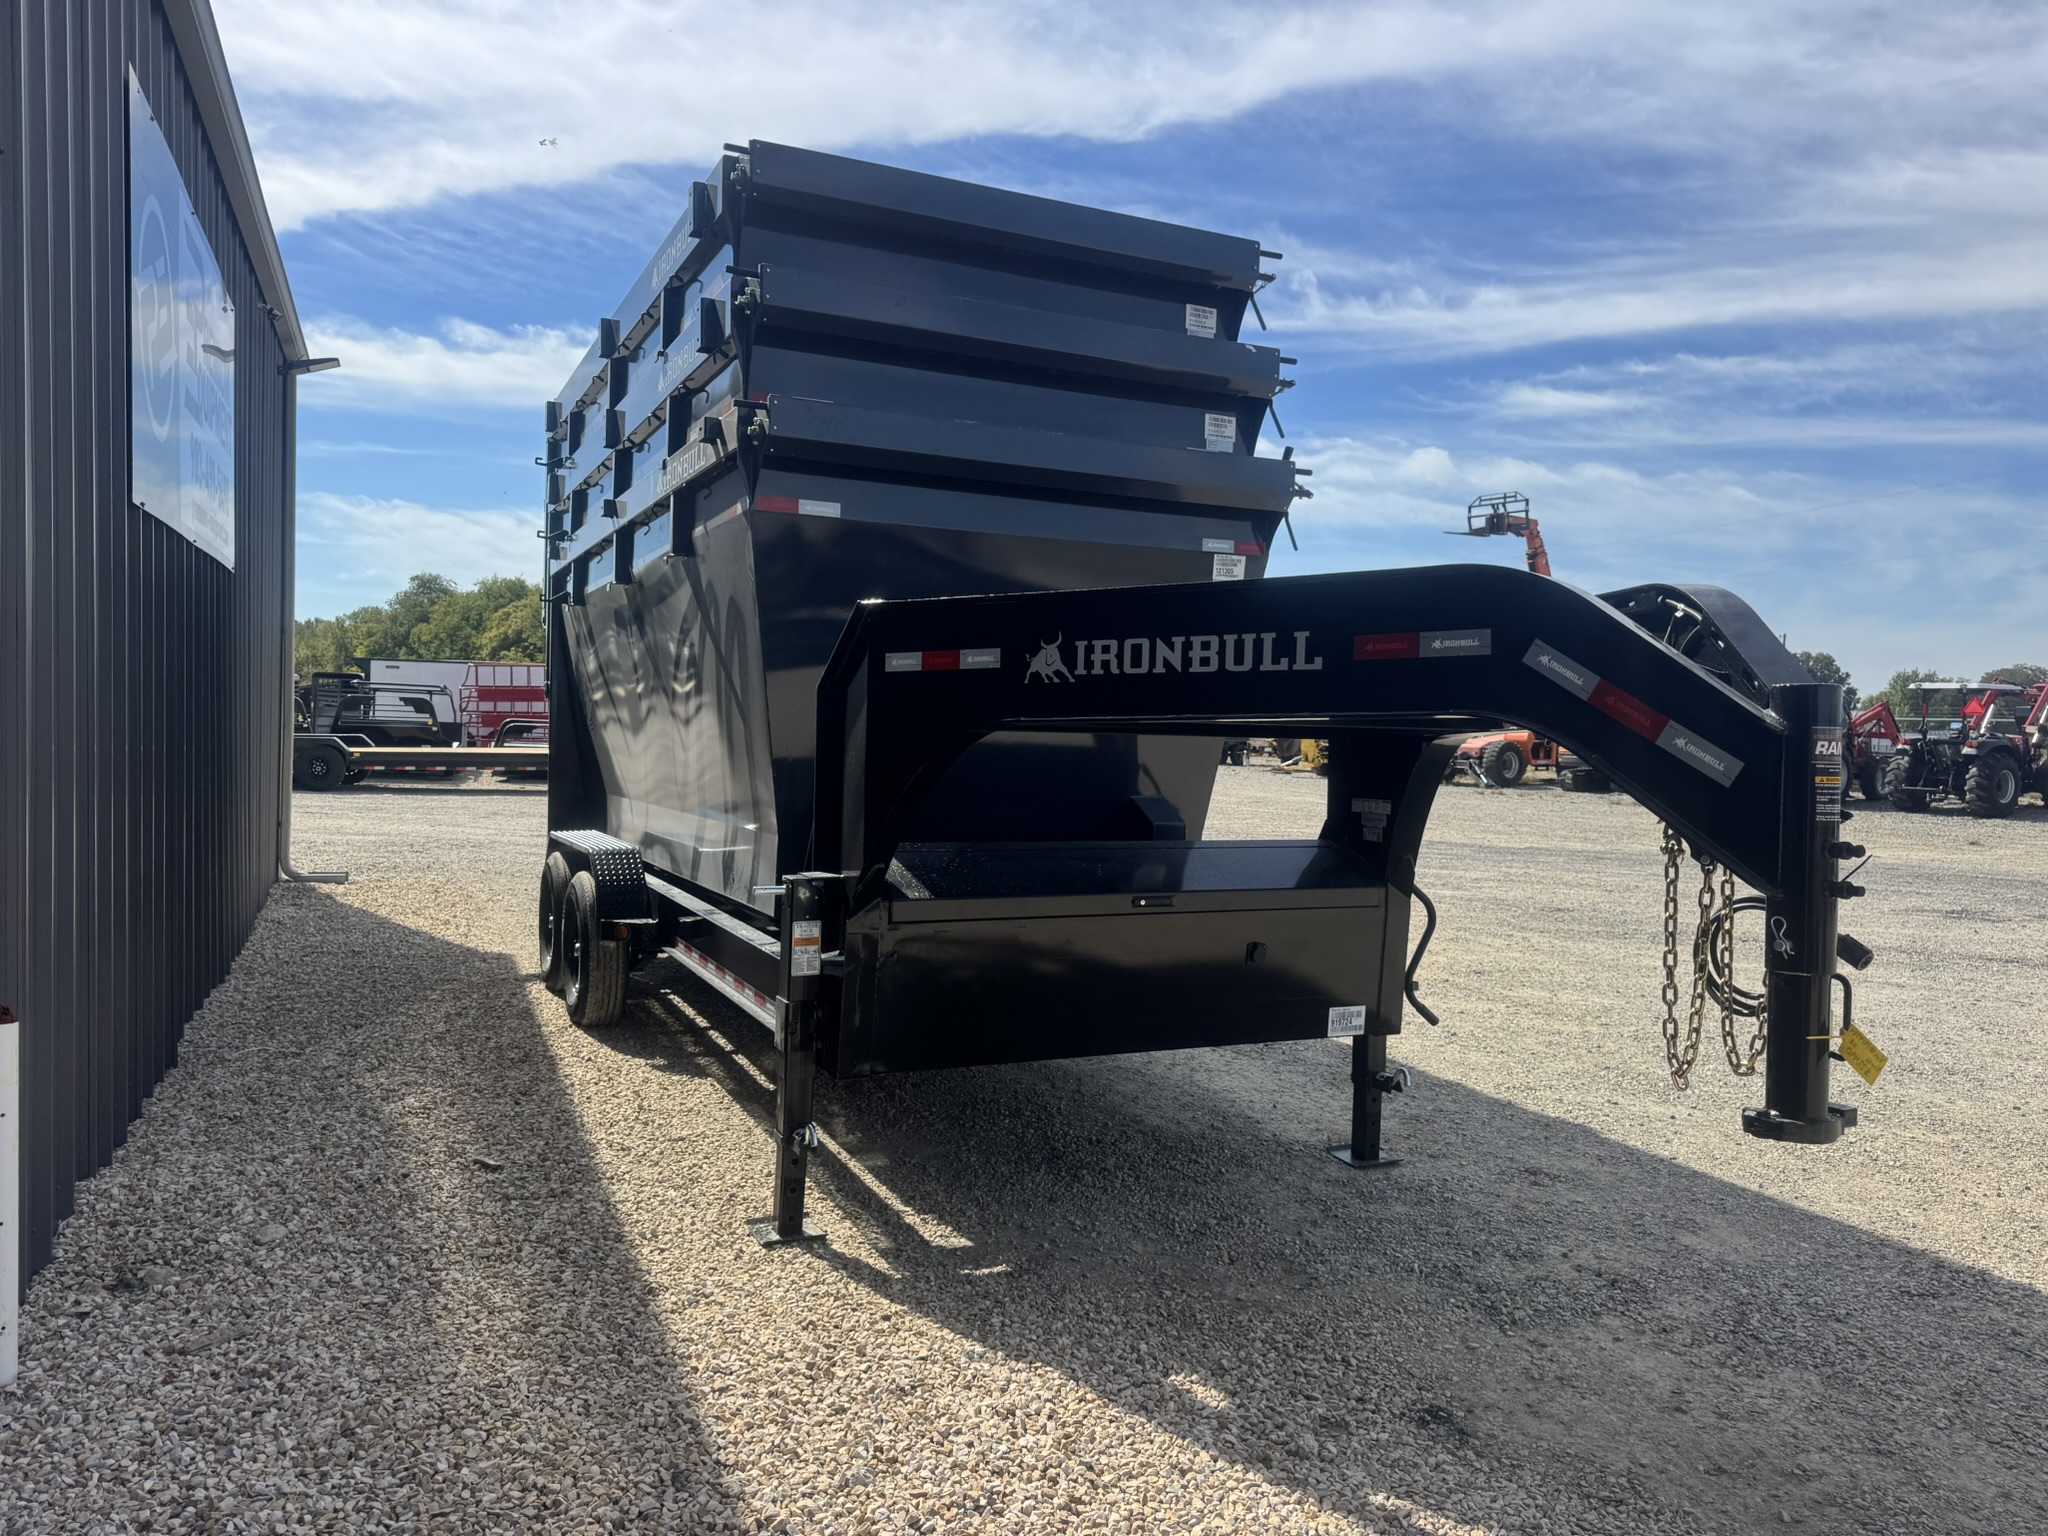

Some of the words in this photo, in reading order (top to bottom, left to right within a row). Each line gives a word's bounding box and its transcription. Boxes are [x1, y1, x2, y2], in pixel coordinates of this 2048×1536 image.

[664, 443, 706, 491] IRONBULL
[1074, 631, 1323, 674] IRONBULL
[1442, 637, 1480, 647] IRONBULL
[1550, 659, 1584, 686] IRONBULL
[1687, 743, 1725, 771] IRONBULL
[1330, 1018, 1353, 1027] 919724
